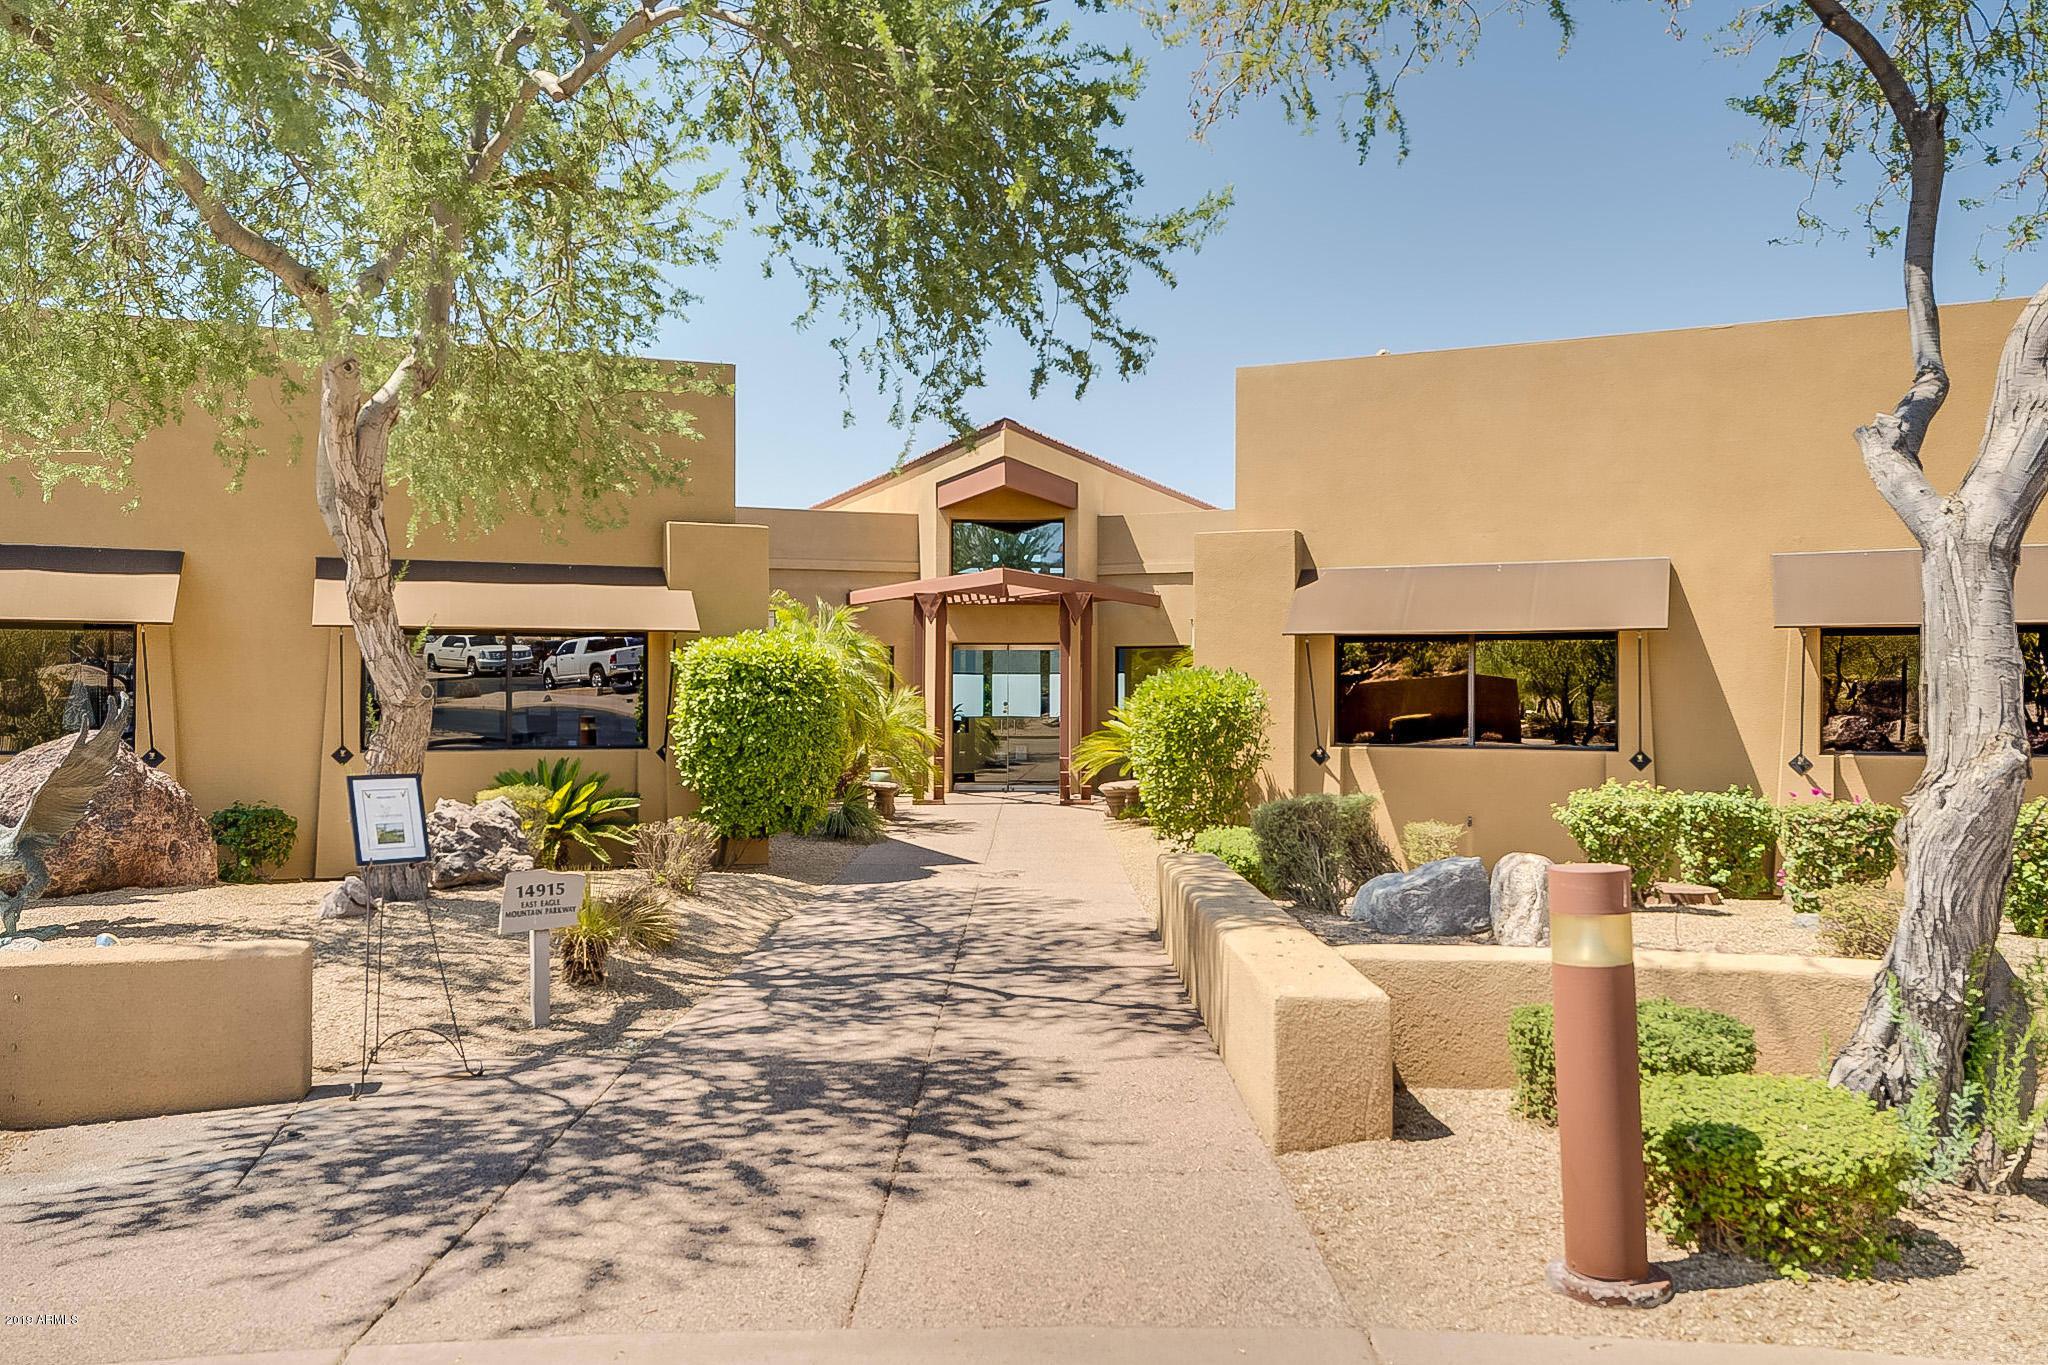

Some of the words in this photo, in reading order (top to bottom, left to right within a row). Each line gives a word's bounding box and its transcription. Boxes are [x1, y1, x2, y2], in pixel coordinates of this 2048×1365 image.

[516, 882, 565, 898] 14915
[521, 900, 537, 909] EAST
[540, 899, 561, 907] EAGLE
[505, 909, 542, 918] MOUNTAIN
[545, 906, 577, 915] PARKWAY
